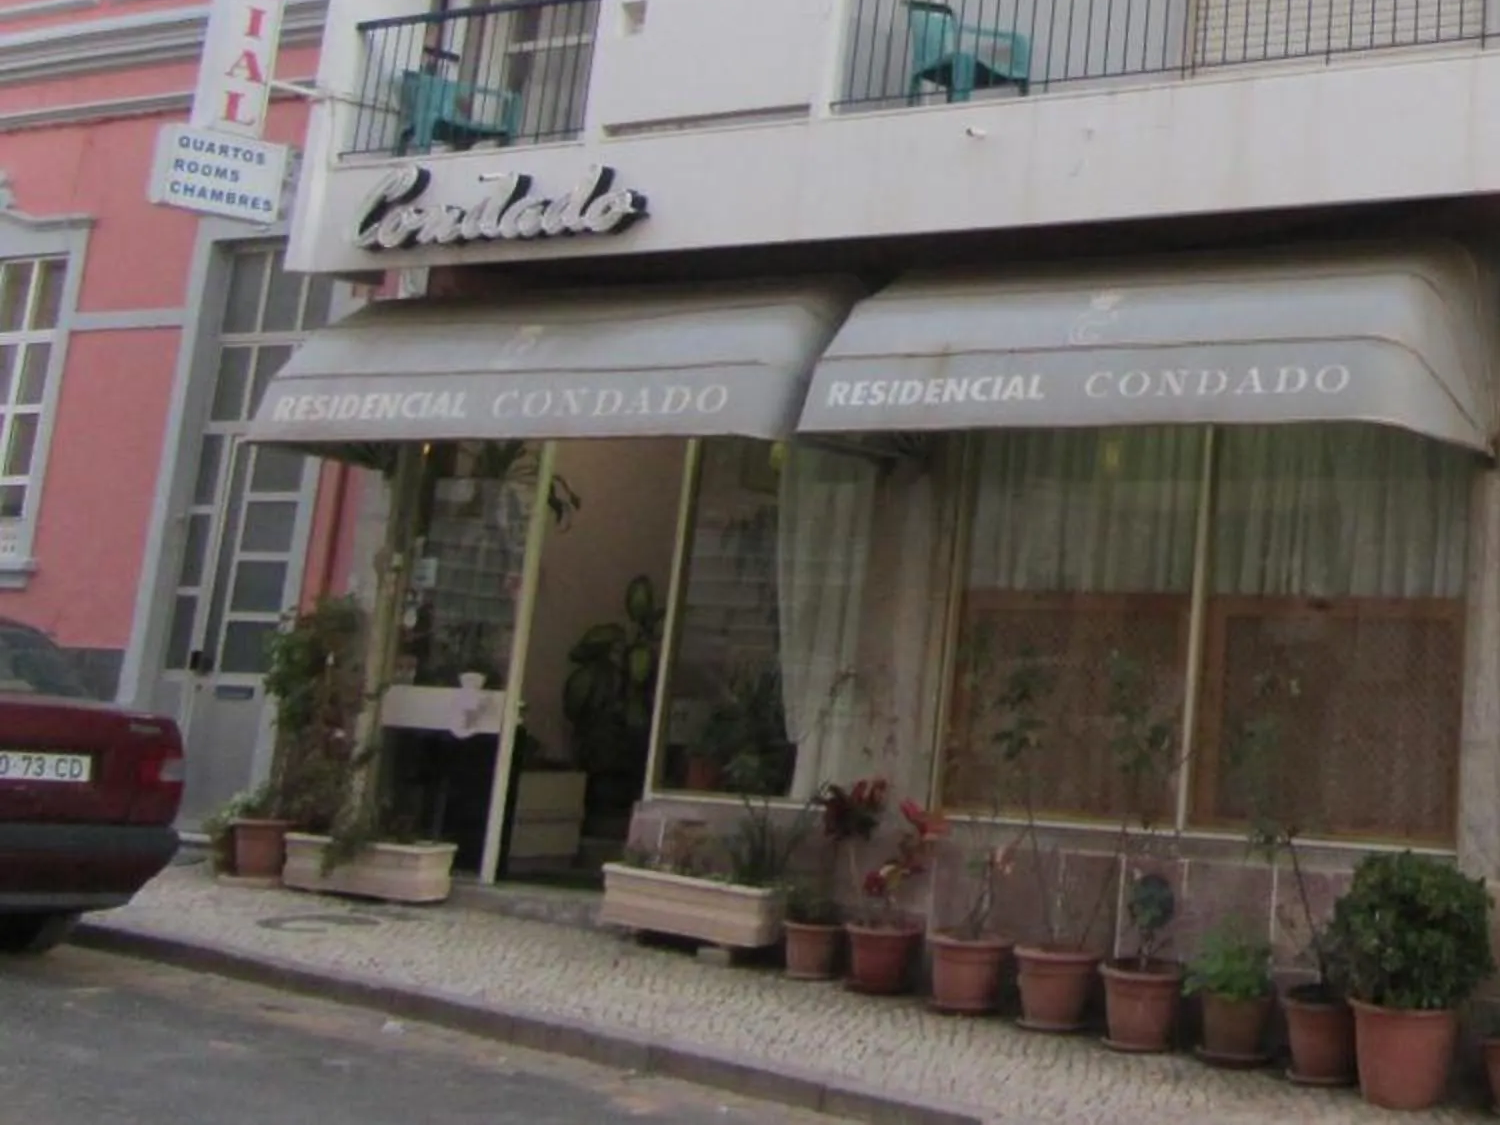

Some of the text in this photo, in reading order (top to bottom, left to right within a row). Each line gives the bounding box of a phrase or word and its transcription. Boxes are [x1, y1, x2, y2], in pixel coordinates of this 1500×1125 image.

[178, 136, 266, 165] QUARTOS
[173, 159, 240, 183] ROOMS
[169, 180, 273, 212] CHAMBRES
[354, 165, 650, 249] Condado
[826, 364, 1351, 407] RESIDENCIAL CONDADO
[272, 385, 729, 422] RESIDENCIAL CONDADO
